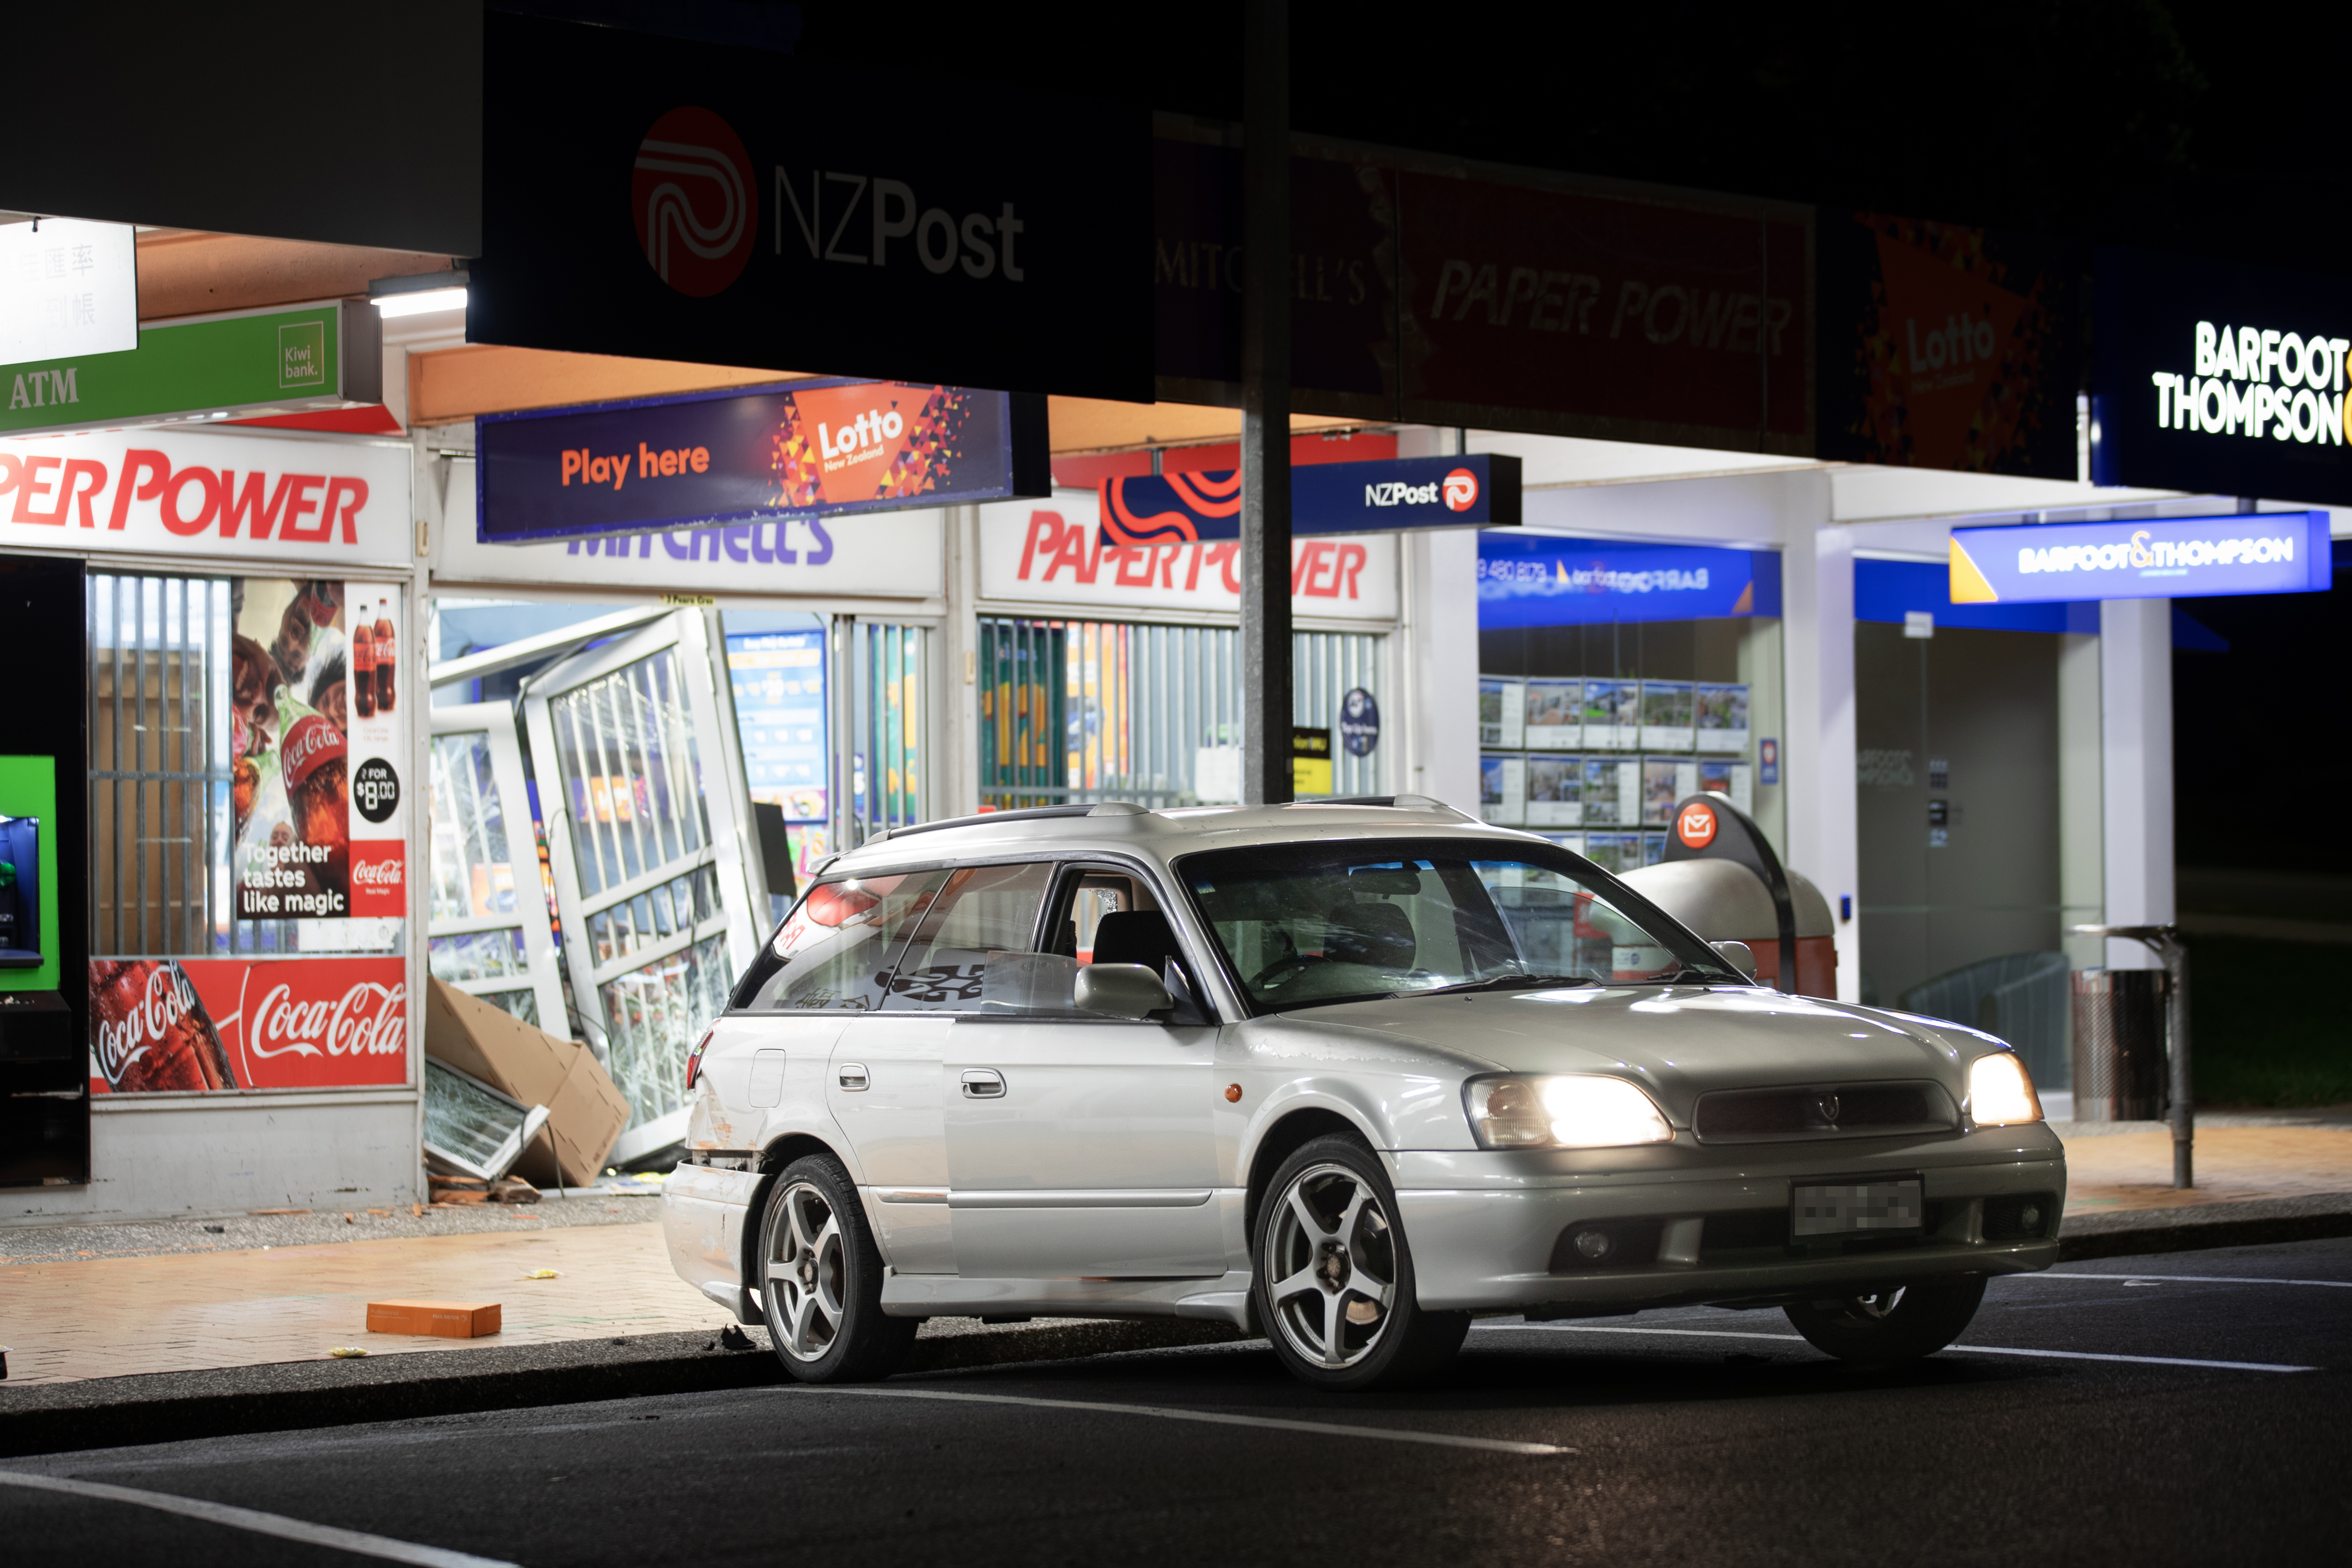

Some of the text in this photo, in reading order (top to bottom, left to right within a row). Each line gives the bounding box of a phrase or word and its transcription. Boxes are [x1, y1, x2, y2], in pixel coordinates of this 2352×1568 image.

[775, 165, 1024, 282] NZPost
[1430, 258, 1792, 356] PAPER POWER
[284, 346, 310, 362] Kiwi
[1906, 312, 1995, 374] Lotto
[2195, 320, 2350, 392] BARFOOT
[9, 368, 80, 410] ATM
[285, 362, 318, 379] bank.
[2152, 371, 2343, 446] THOMPSON
[818, 409, 903, 460] Lotto
[562, 442, 710, 490] Play here
[824, 444, 884, 473] New Zealand
[107, 448, 369, 545] POWER
[1366, 481, 1438, 507] NZPost
[1017, 510, 1182, 588] PAPER
[368, 768, 387, 780] FOR
[242, 840, 332, 867] Together
[242, 868, 306, 888] tastes
[243, 888, 345, 916] like magic
